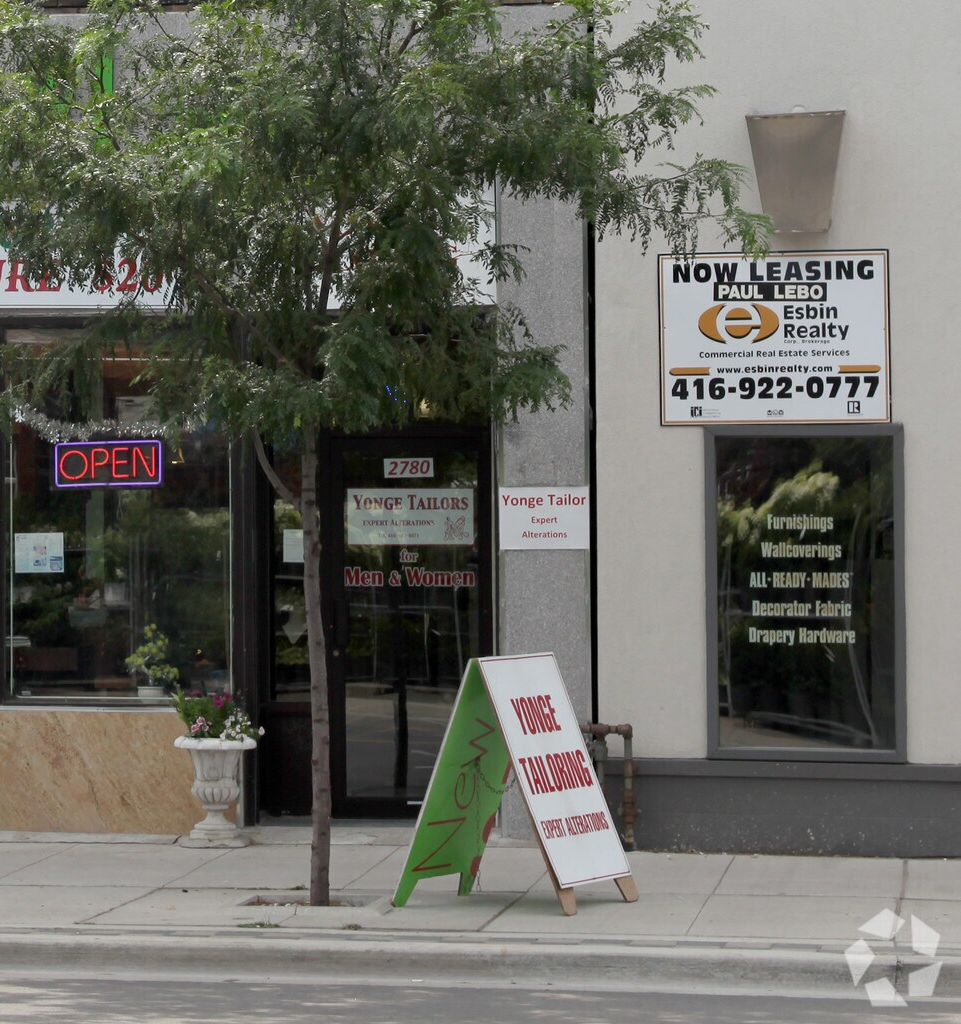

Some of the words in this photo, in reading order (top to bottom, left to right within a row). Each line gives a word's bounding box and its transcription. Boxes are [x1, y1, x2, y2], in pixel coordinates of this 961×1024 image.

[672, 262, 738, 283] NOW
[750, 259, 875, 281] LEASING
[718, 284, 764, 300] PAUL
[774, 284, 824, 299] LEBO
[783, 303, 838, 320] Esbin
[783, 322, 849, 340] Realty
[699, 350, 754, 359] Commercial
[756, 350, 776, 358] Real
[778, 349, 809, 357] Estate
[811, 348, 850, 357] Services
[716, 364, 833, 374] www.esbinrealty.com
[671, 376, 880, 400] 416-922-0777
[60, 446, 156, 480] OPEN
[388, 459, 431, 476] 2780
[502, 494, 544, 509] Yonge
[547, 493, 587, 506] Tailor
[531, 516, 558, 525] Expert
[767, 514, 834, 533] Furnishings
[521, 530, 568, 539] Alterations
[399, 548, 418, 563] for
[760, 542, 842, 561] Wallcoverings
[344, 567, 384, 587] Men
[389, 570, 401, 587] &
[404, 567, 475, 587] Women
[751, 600, 812, 617] Decorator
[815, 600, 852, 617] Fabric
[748, 627, 795, 646] Drapery
[798, 627, 856, 643] Hardware
[510, 694, 561, 736] YONGE
[518, 749, 594, 796] TAILORING
[540, 817, 567, 840] EXPERT
[565, 811, 610, 835] ALTERATIONS
